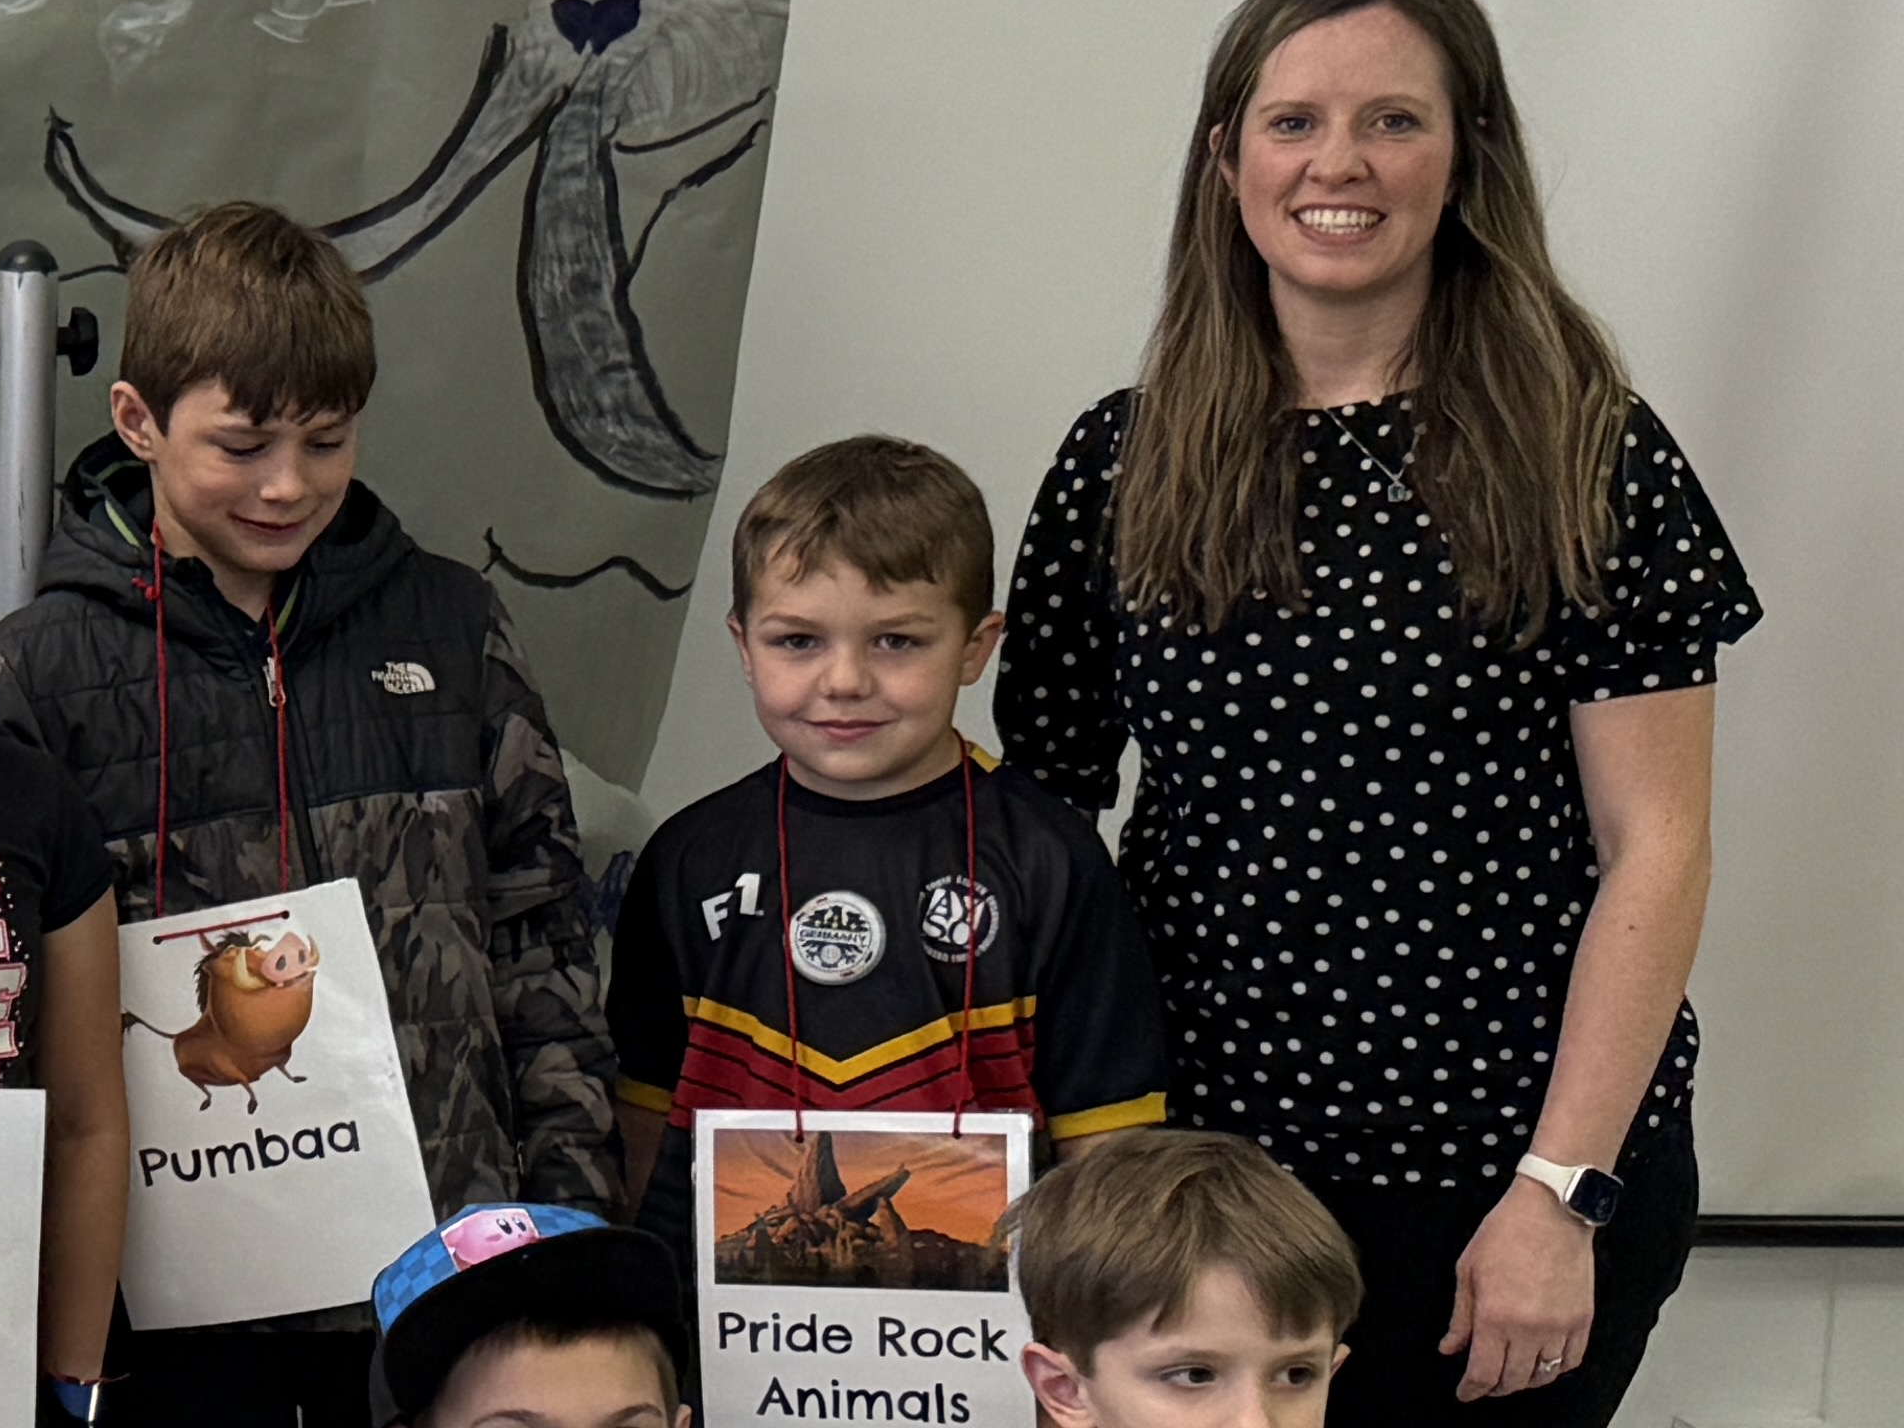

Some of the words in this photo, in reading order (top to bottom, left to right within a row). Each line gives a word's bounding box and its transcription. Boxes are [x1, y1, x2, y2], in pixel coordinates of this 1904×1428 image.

[140, 1117, 362, 1188] Pumbaa
[716, 1310, 854, 1358] Pride
[876, 1315, 1010, 1362] Rock
[756, 1379, 972, 1426] Animals
